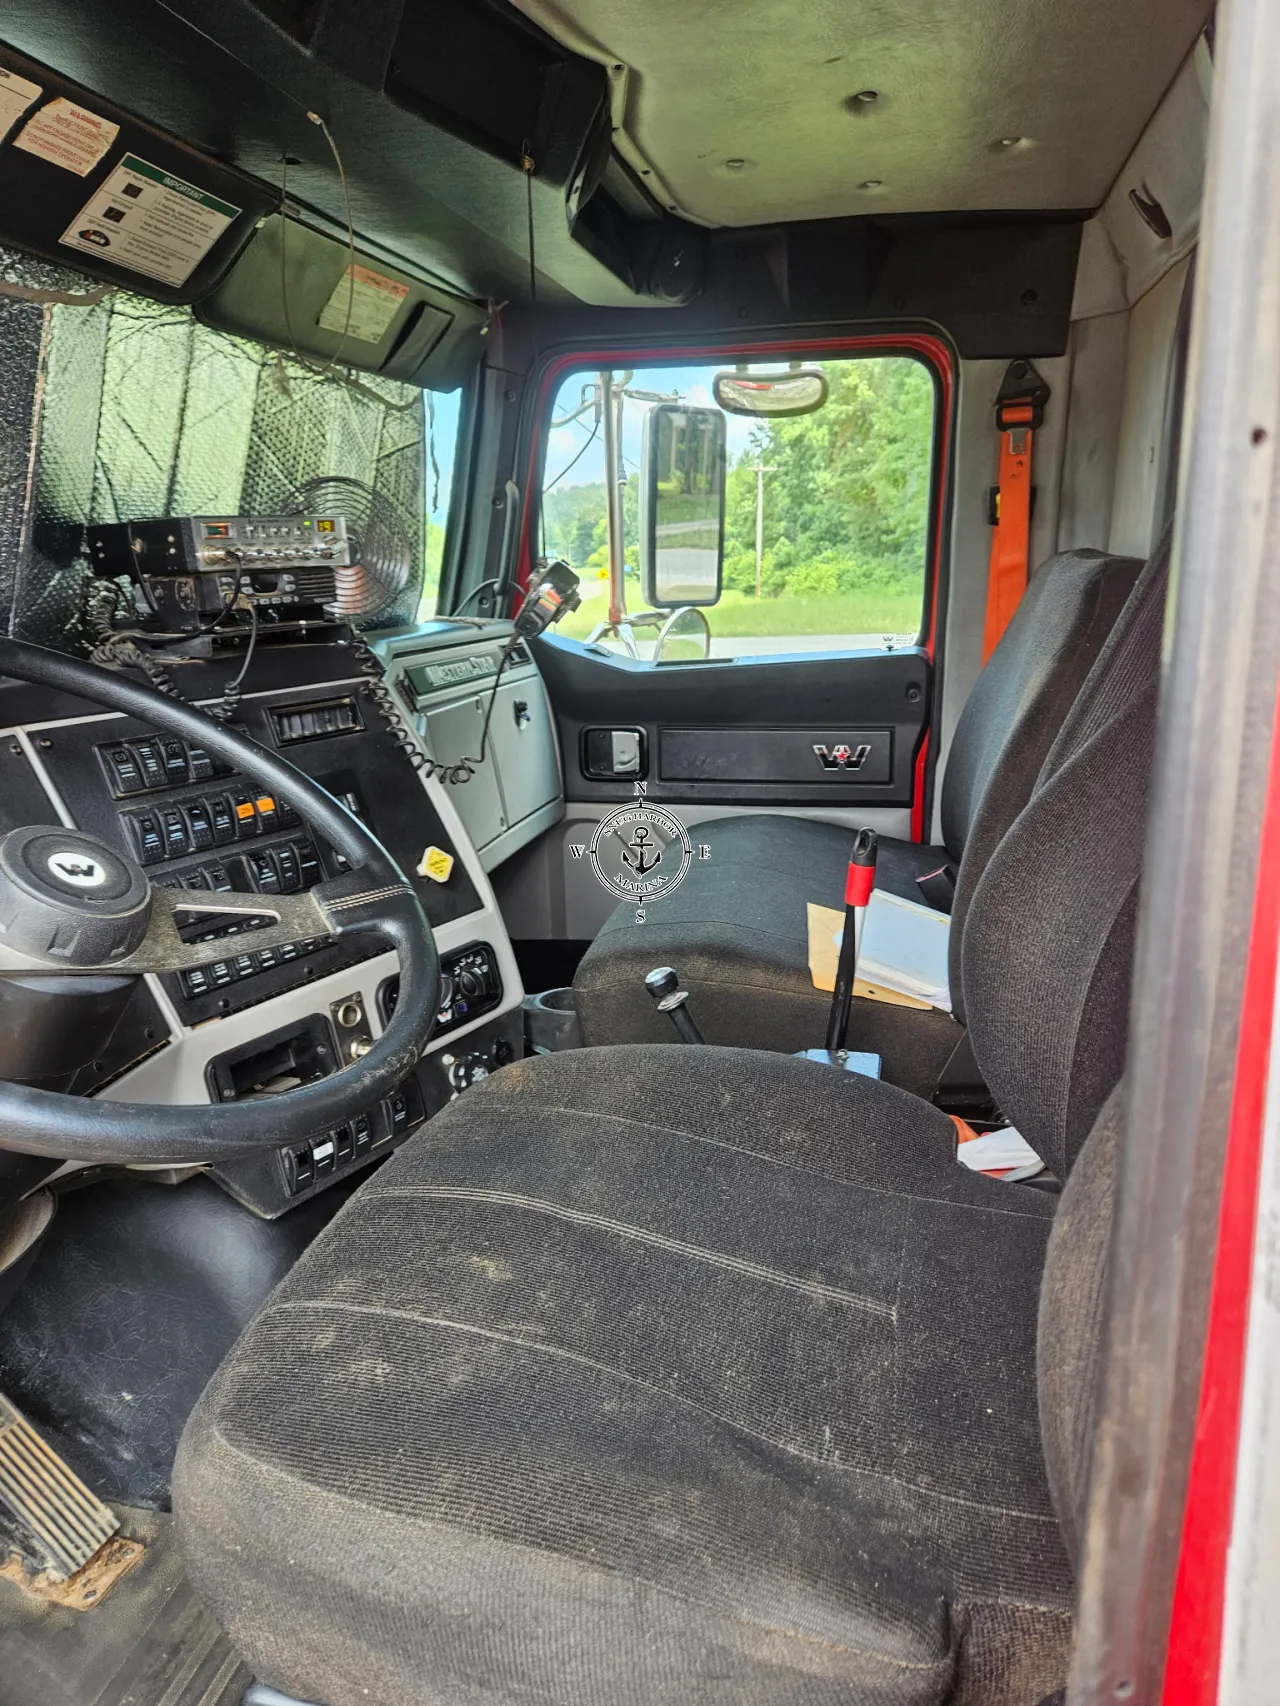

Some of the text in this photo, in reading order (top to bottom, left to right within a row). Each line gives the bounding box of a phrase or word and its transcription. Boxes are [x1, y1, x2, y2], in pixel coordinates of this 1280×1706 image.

[163, 176, 204, 200] IMPORTANT
[424, 656, 496, 685] WESTERN STAR
